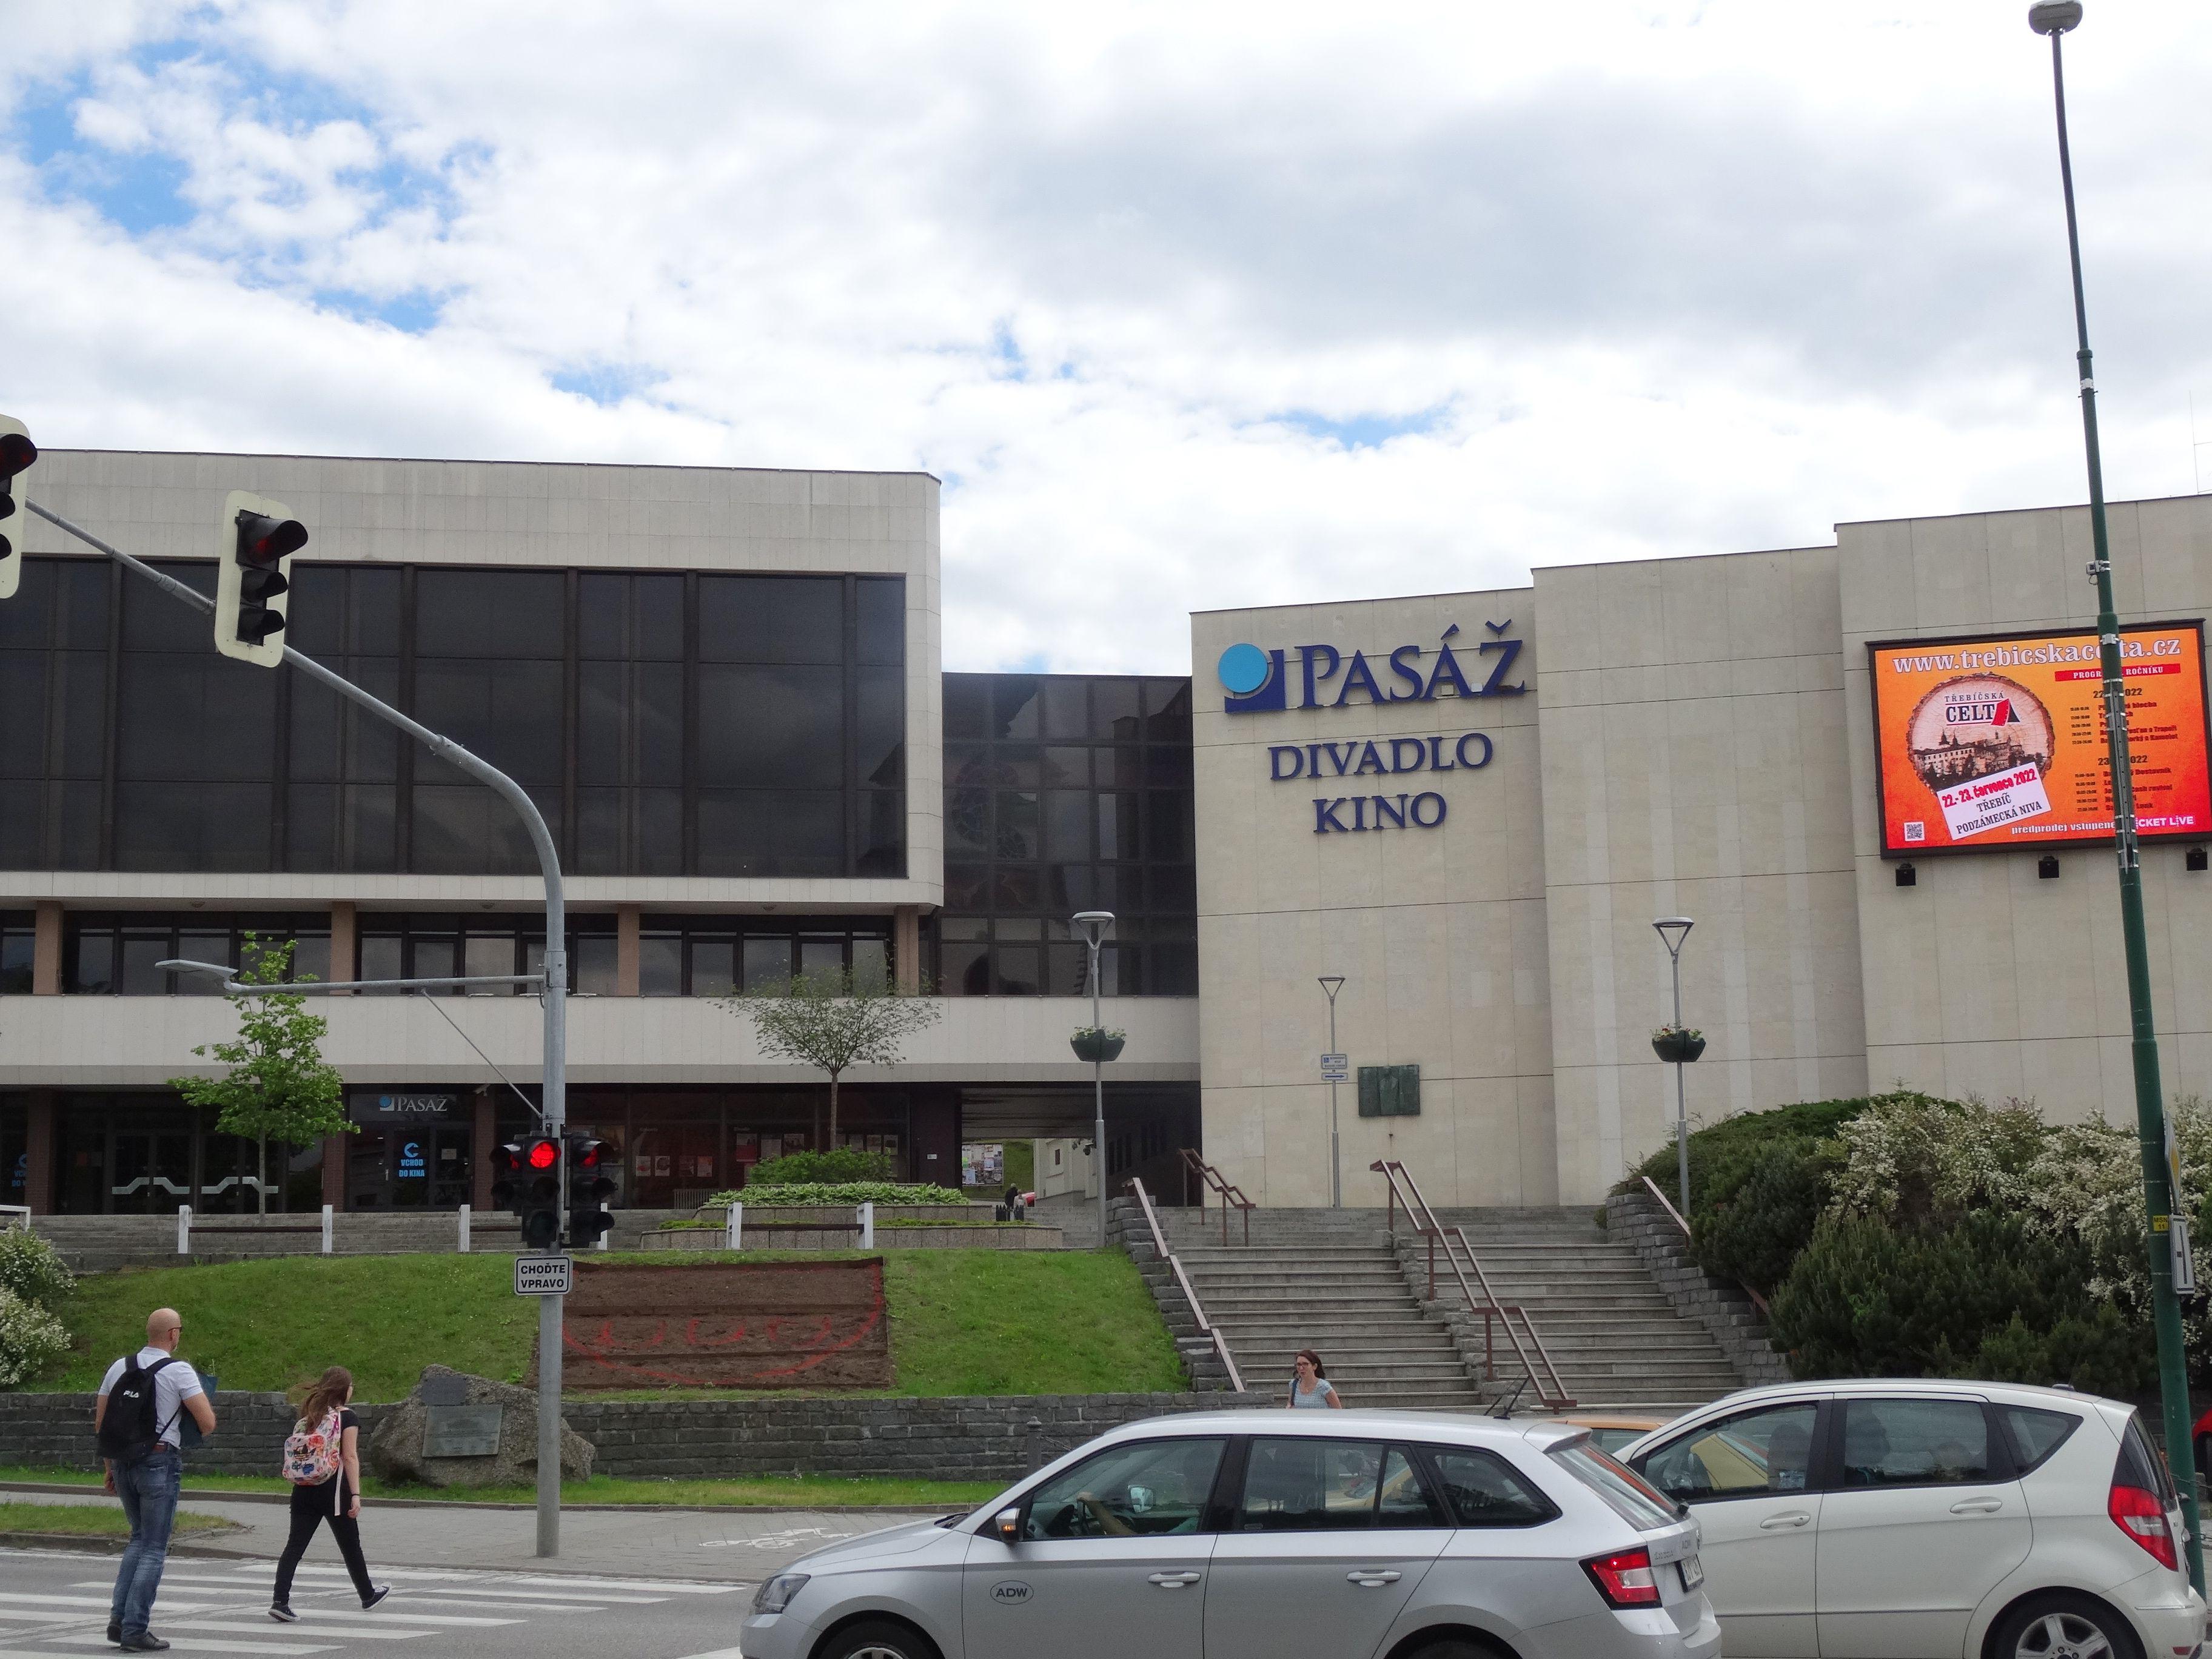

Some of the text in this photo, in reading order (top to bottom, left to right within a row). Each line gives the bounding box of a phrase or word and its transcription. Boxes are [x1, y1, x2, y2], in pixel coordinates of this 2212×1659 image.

[1294, 618, 1526, 709] PASÁŽ
[1892, 638, 2181, 674] www.trebicskacta.cz
[2126, 666, 2163, 675] ROČNÍKU
[1945, 690, 2004, 702] TŘEBÍČSKÁ
[1267, 732, 1493, 781] DIVADLO
[2013, 768, 2037, 786] 2022
[1976, 792, 2011, 812] TŘEBÍČ
[1313, 791, 1447, 833] KINO
[1956, 801, 2042, 834] PODZÁMECKÁ NIVA
[2011, 823, 2068, 835] předprodej
[2070, 822, 2115, 832] vstupene
[521, 1262, 566, 1275] CHOĎTE
[521, 1279, 565, 1289] VPRAVO
[996, 1587, 1028, 1597] ADW
